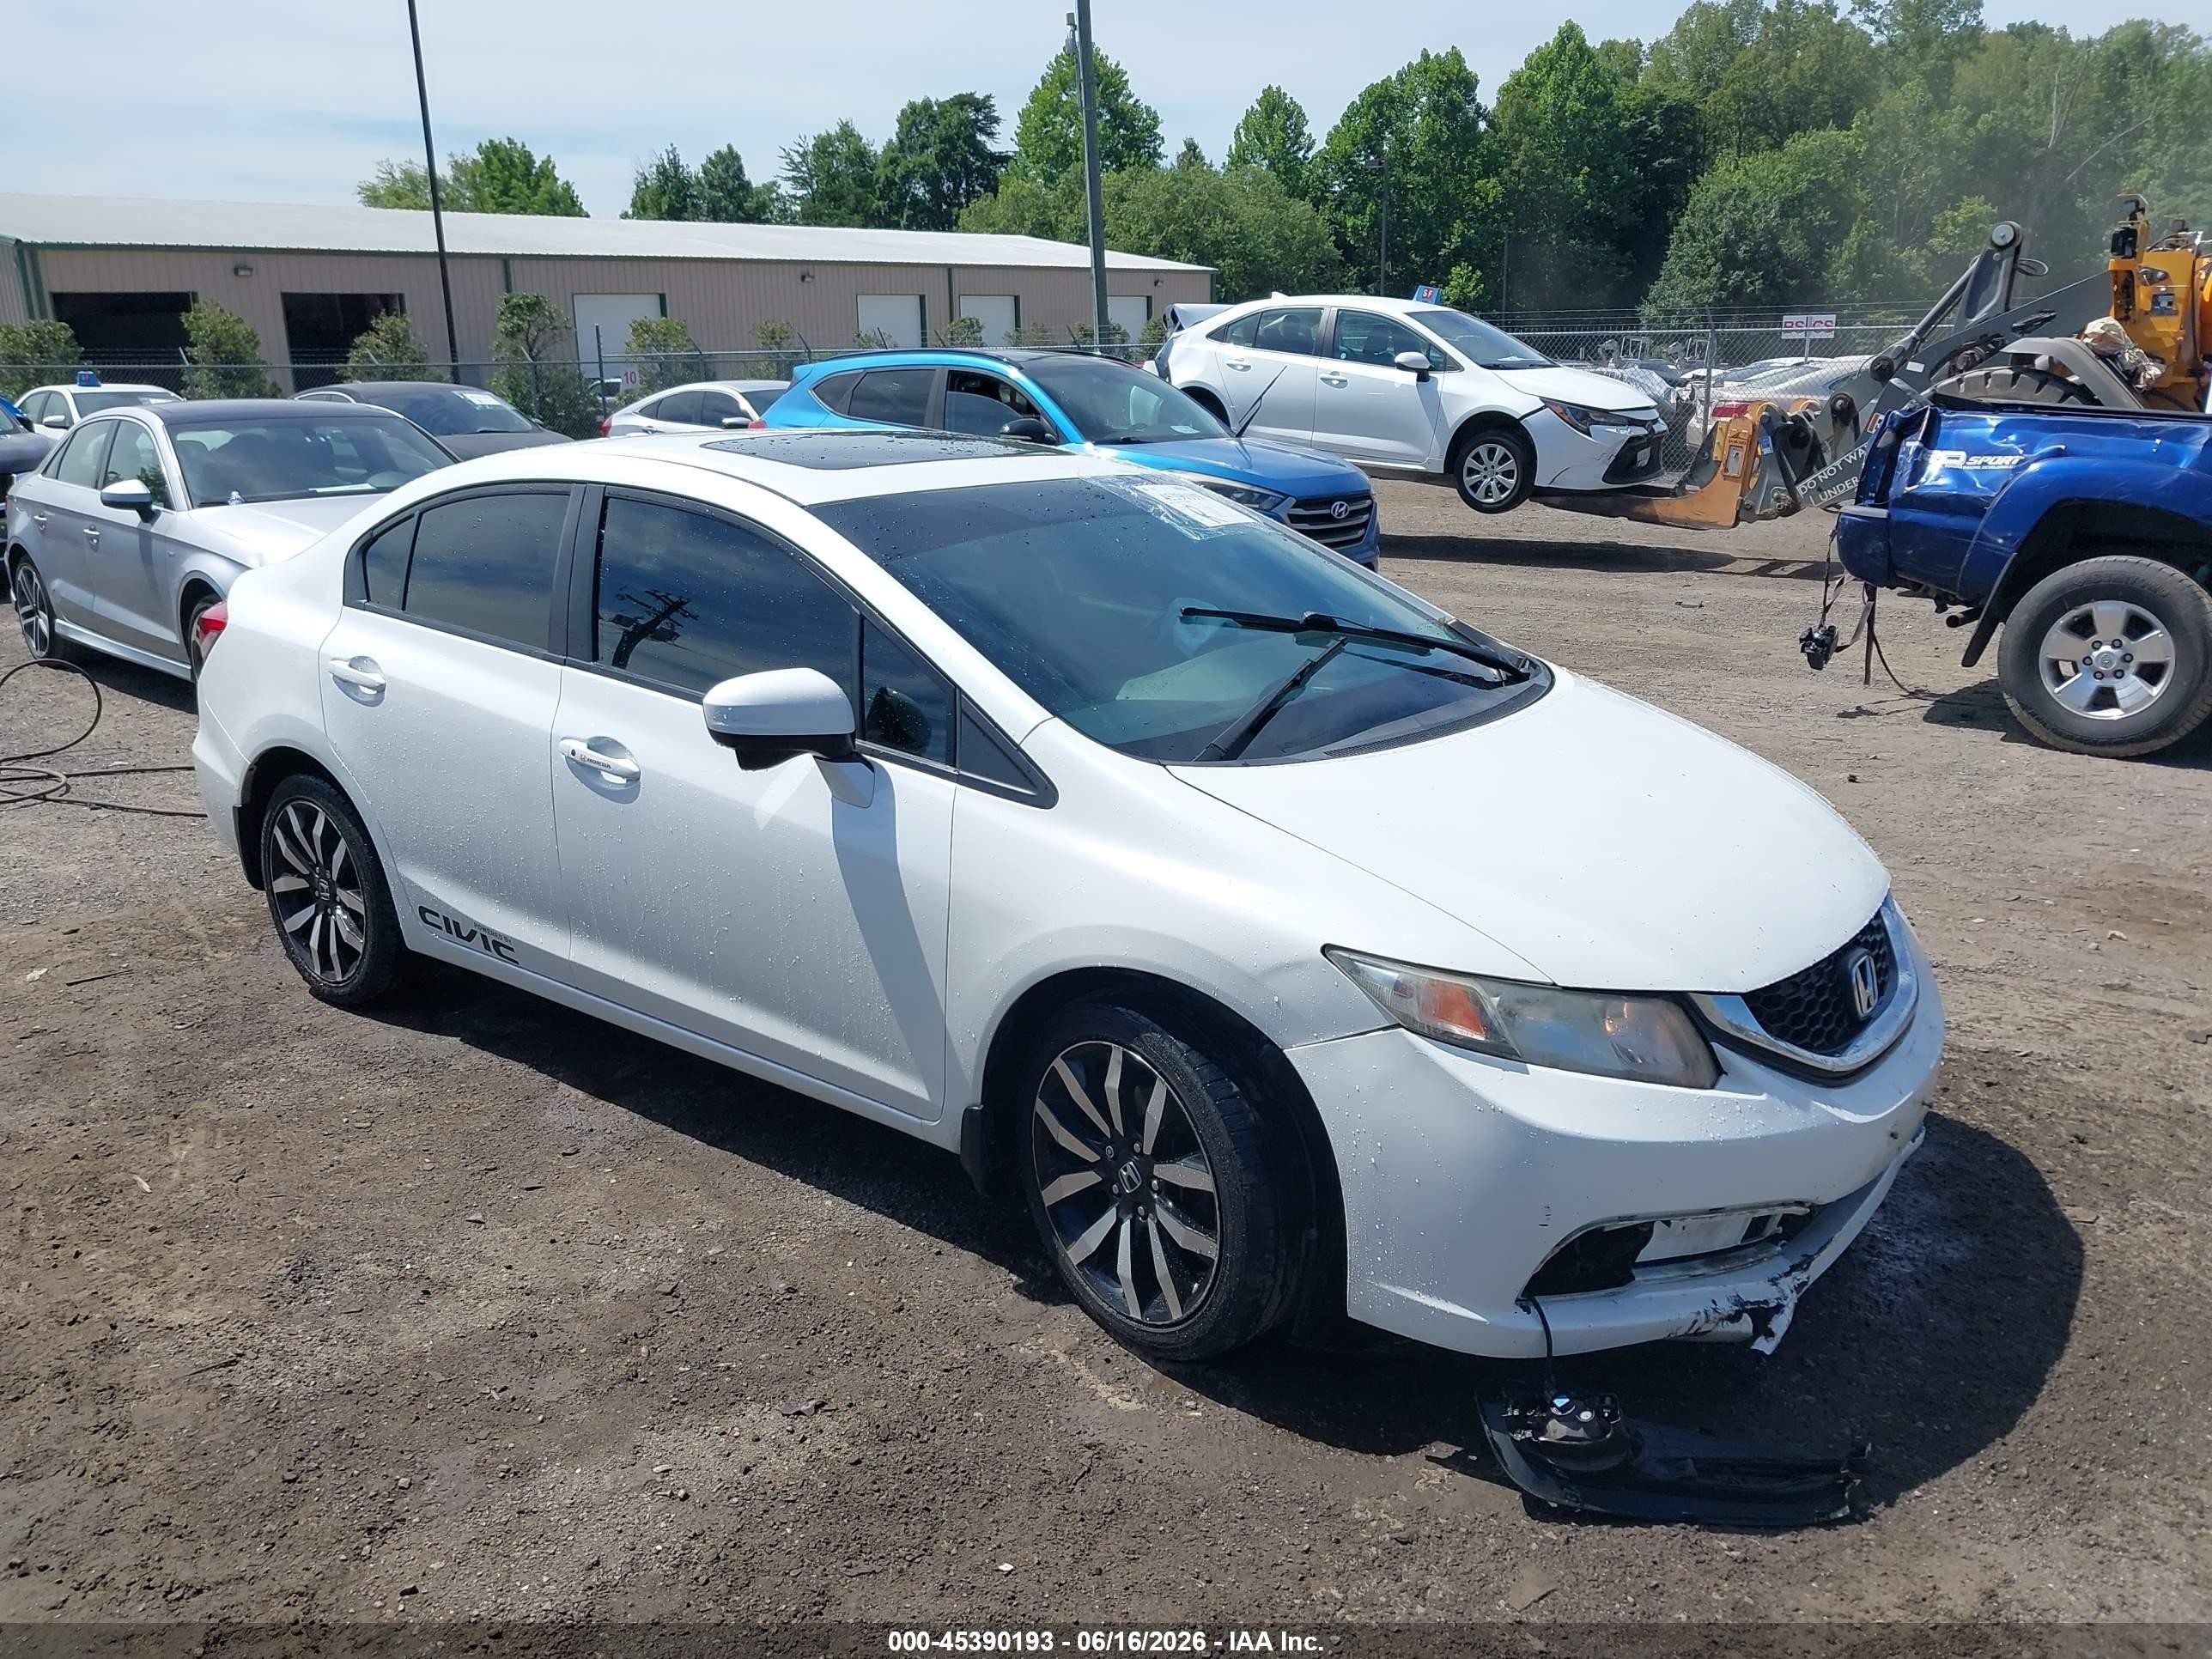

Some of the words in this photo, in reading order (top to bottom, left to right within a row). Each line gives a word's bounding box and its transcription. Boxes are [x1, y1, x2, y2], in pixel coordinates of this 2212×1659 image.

[623, 371, 636, 384] 10
[1966, 455, 2025, 465] SPORT
[1798, 480, 1817, 495] DO
[1818, 460, 1844, 483] NOT
[1844, 445, 1867, 464] WA
[1819, 477, 1859, 501] UNDER
[586, 757, 611, 769] HONDA
[418, 905, 520, 965] CIVIC
